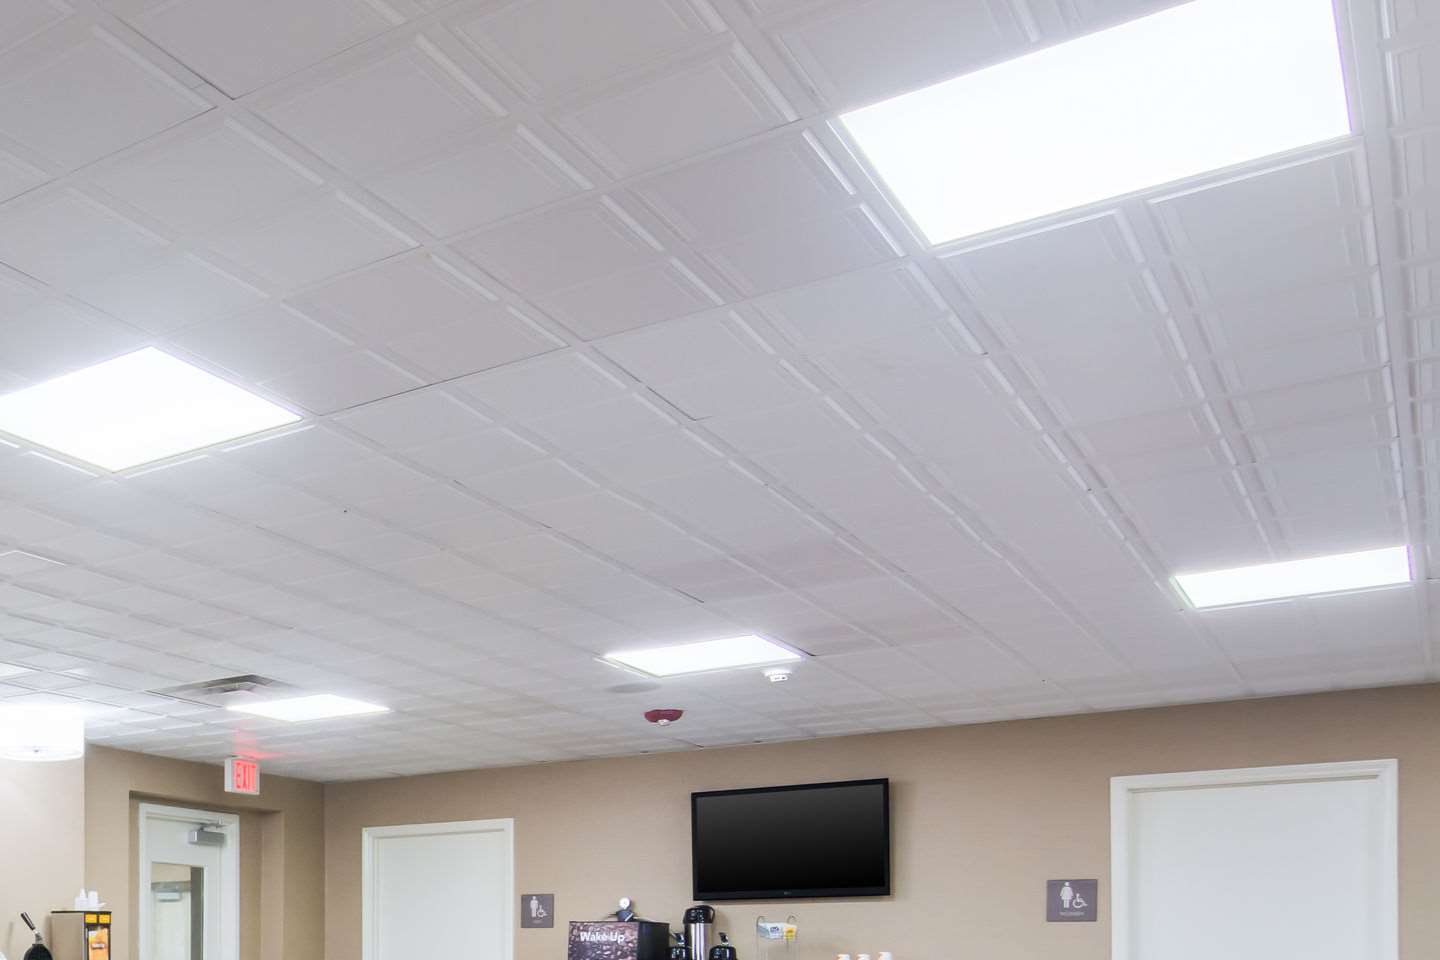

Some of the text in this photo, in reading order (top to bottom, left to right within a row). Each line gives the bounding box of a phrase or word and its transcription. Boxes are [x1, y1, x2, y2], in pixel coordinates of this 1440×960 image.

[235, 761, 257, 790] EXIT
[579, 930, 626, 944] Wake Up
